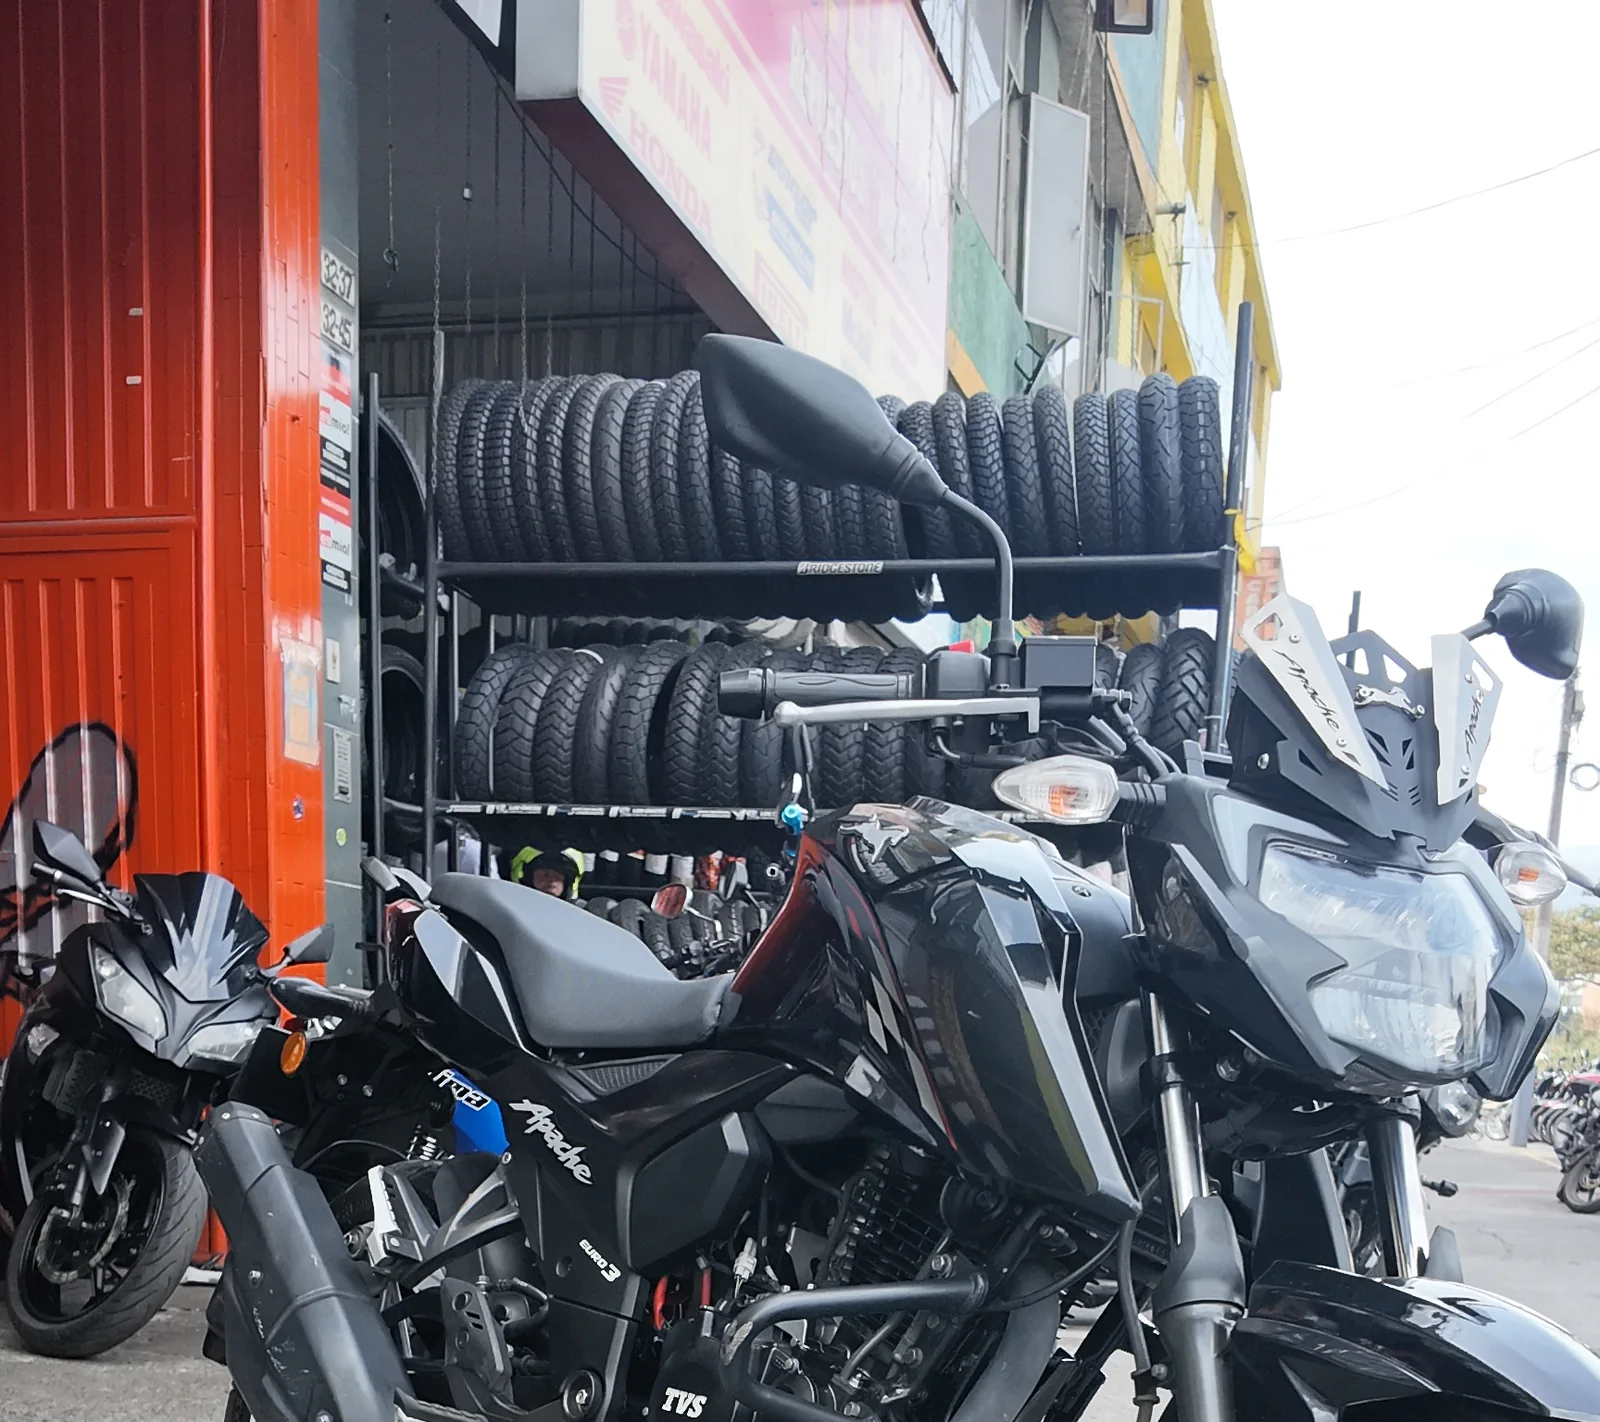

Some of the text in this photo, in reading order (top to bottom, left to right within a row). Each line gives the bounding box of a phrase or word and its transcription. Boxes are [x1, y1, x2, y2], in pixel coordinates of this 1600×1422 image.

[640, 11, 712, 164] YAMAHA
[628, 104, 715, 243] HONDA
[1271, 648, 1341, 732] Apache
[508, 1098, 594, 1186] Apache
[661, 1387, 707, 1419] TVS
